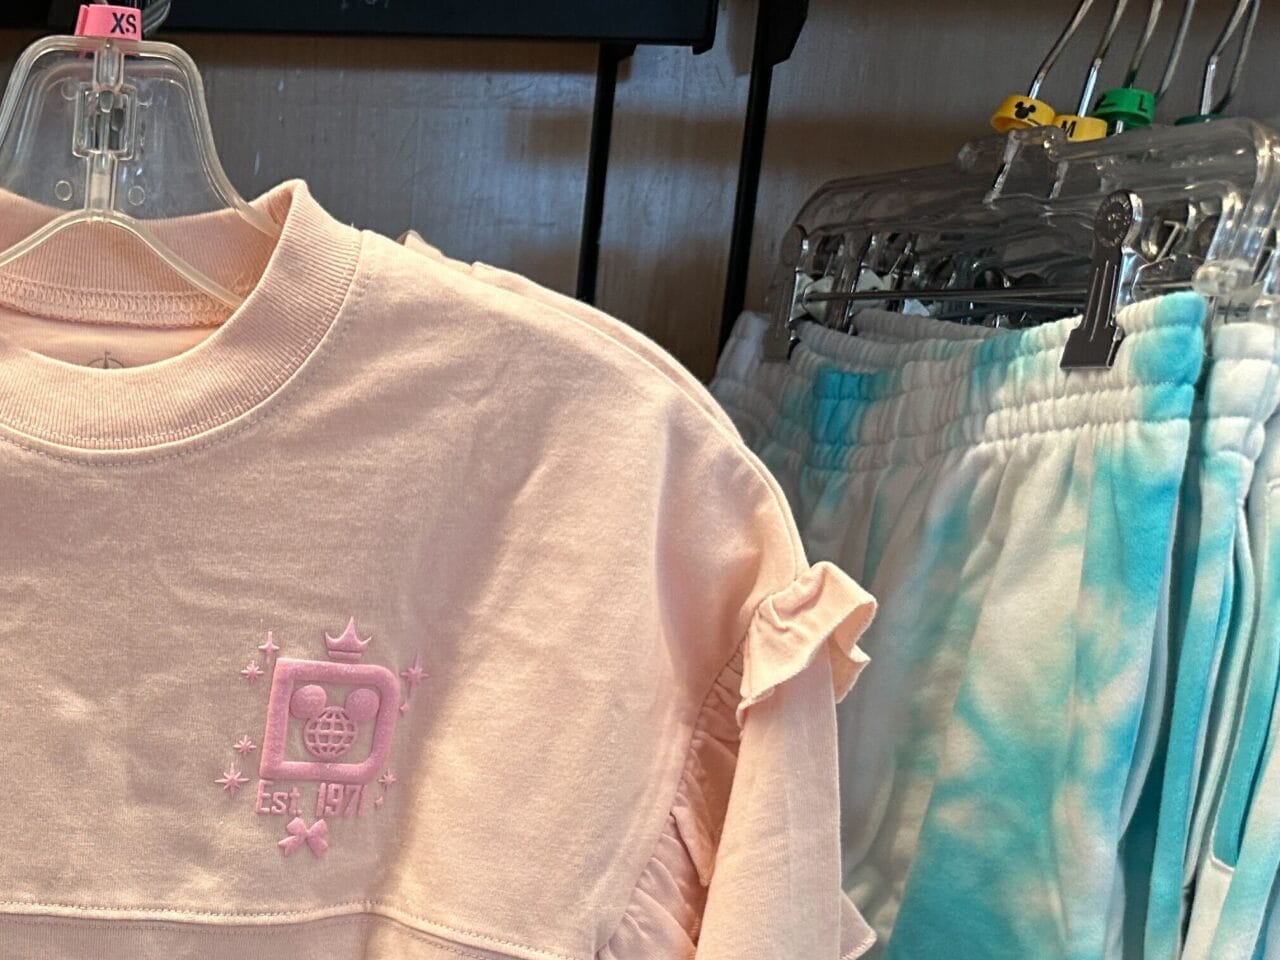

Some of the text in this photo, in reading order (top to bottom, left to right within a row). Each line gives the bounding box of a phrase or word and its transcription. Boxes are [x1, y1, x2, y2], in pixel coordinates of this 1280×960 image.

[110, 12, 137, 34] XS
[1138, 93, 1148, 114] L
[1061, 120, 1077, 138] M
[256, 779, 369, 818] Est. 1971
